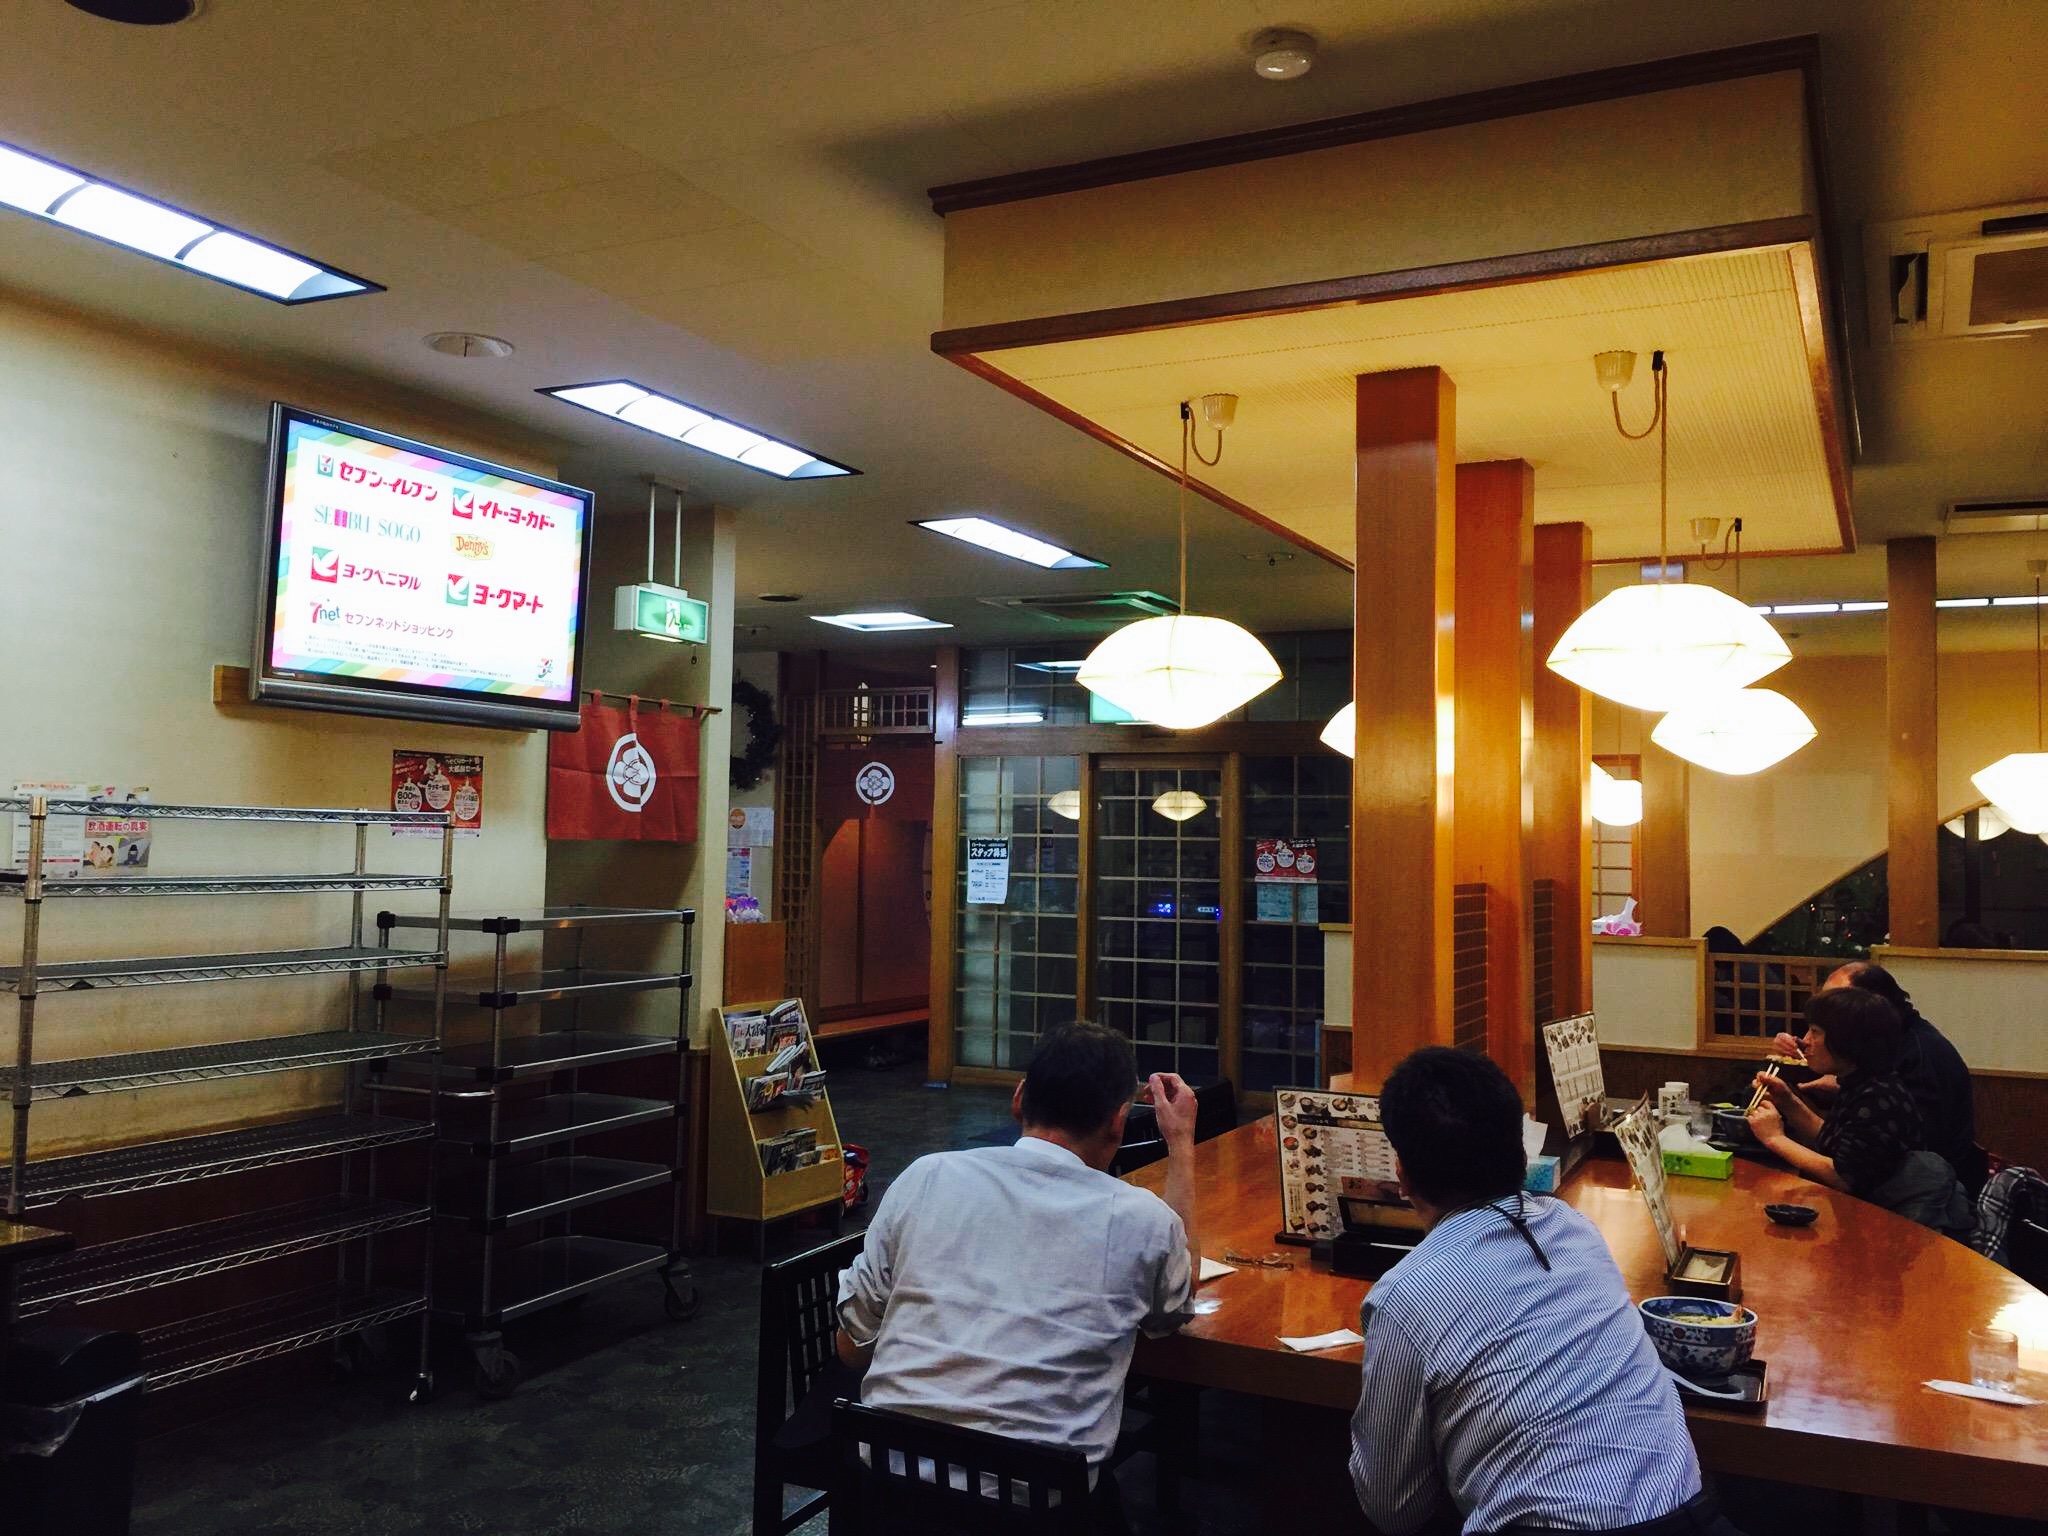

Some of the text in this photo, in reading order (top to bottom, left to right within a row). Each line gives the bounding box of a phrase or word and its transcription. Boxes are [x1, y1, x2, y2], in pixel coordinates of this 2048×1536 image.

[377, 518, 421, 543] SOGO
[456, 535, 489, 556] Denny's
[473, 583, 544, 614] ヨークマート
